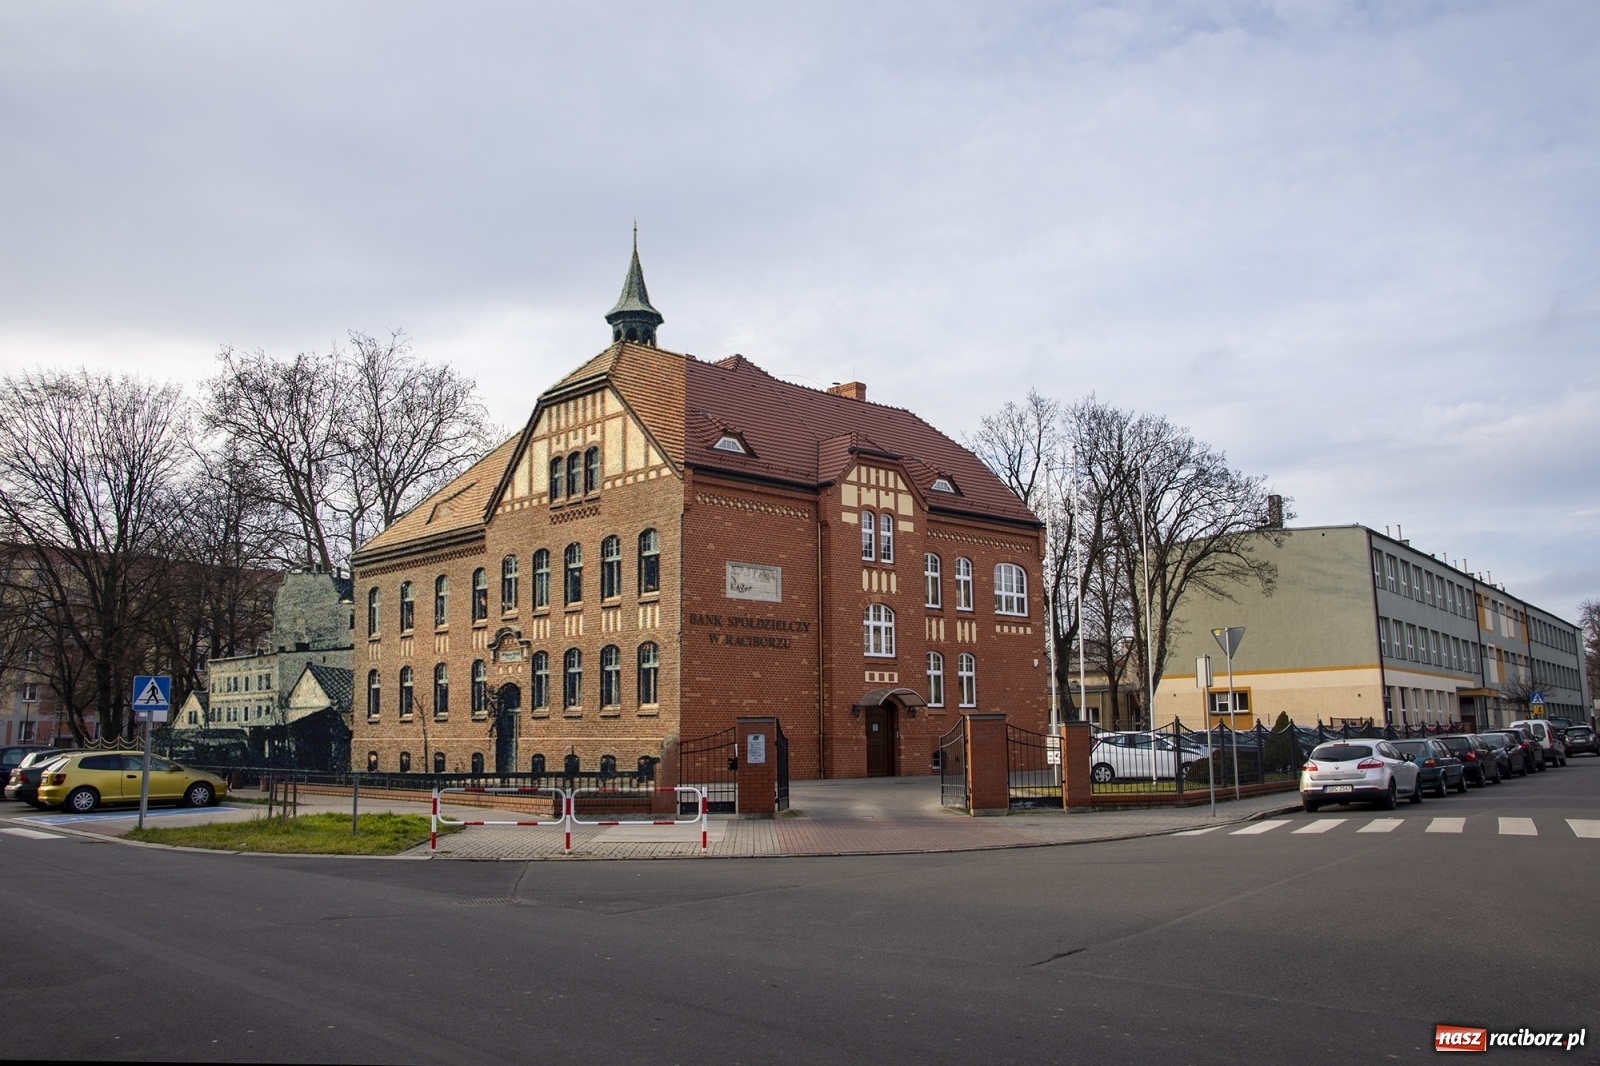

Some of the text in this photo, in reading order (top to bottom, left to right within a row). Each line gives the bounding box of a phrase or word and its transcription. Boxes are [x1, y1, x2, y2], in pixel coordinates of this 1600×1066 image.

[690, 613, 722, 627] BANK
[709, 633, 790, 649] W RACIBORZU
